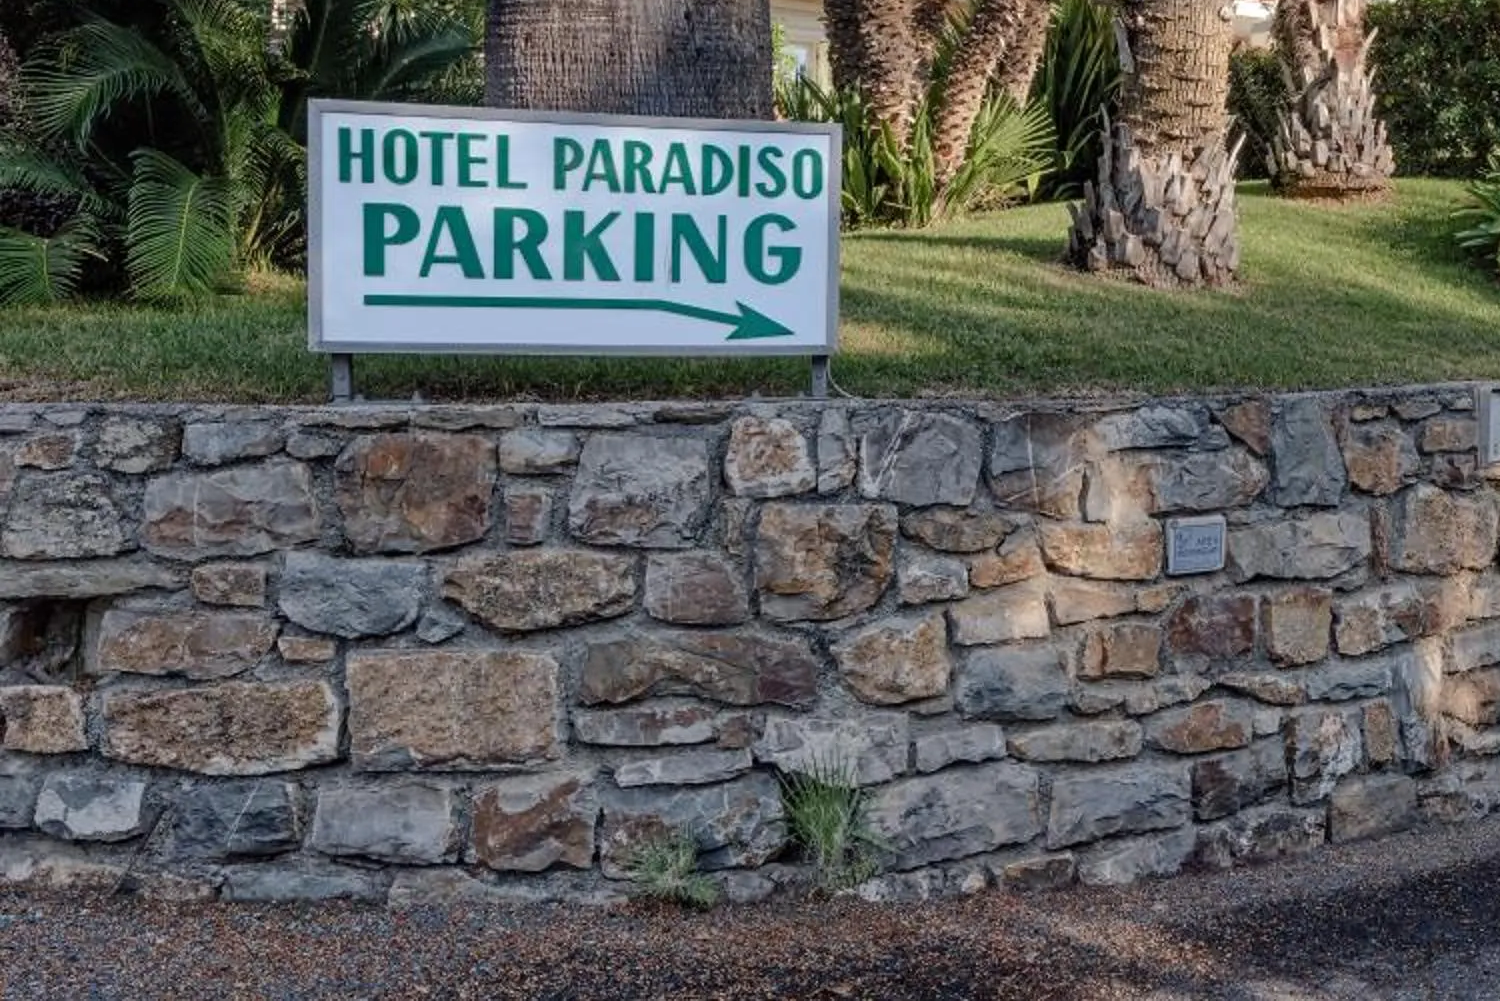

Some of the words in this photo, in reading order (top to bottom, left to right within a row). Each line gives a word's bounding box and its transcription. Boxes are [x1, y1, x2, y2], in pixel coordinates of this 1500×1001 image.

[338, 127, 527, 189] HOTEL
[553, 137, 823, 199] PARADISO
[363, 203, 802, 285] PARKING
